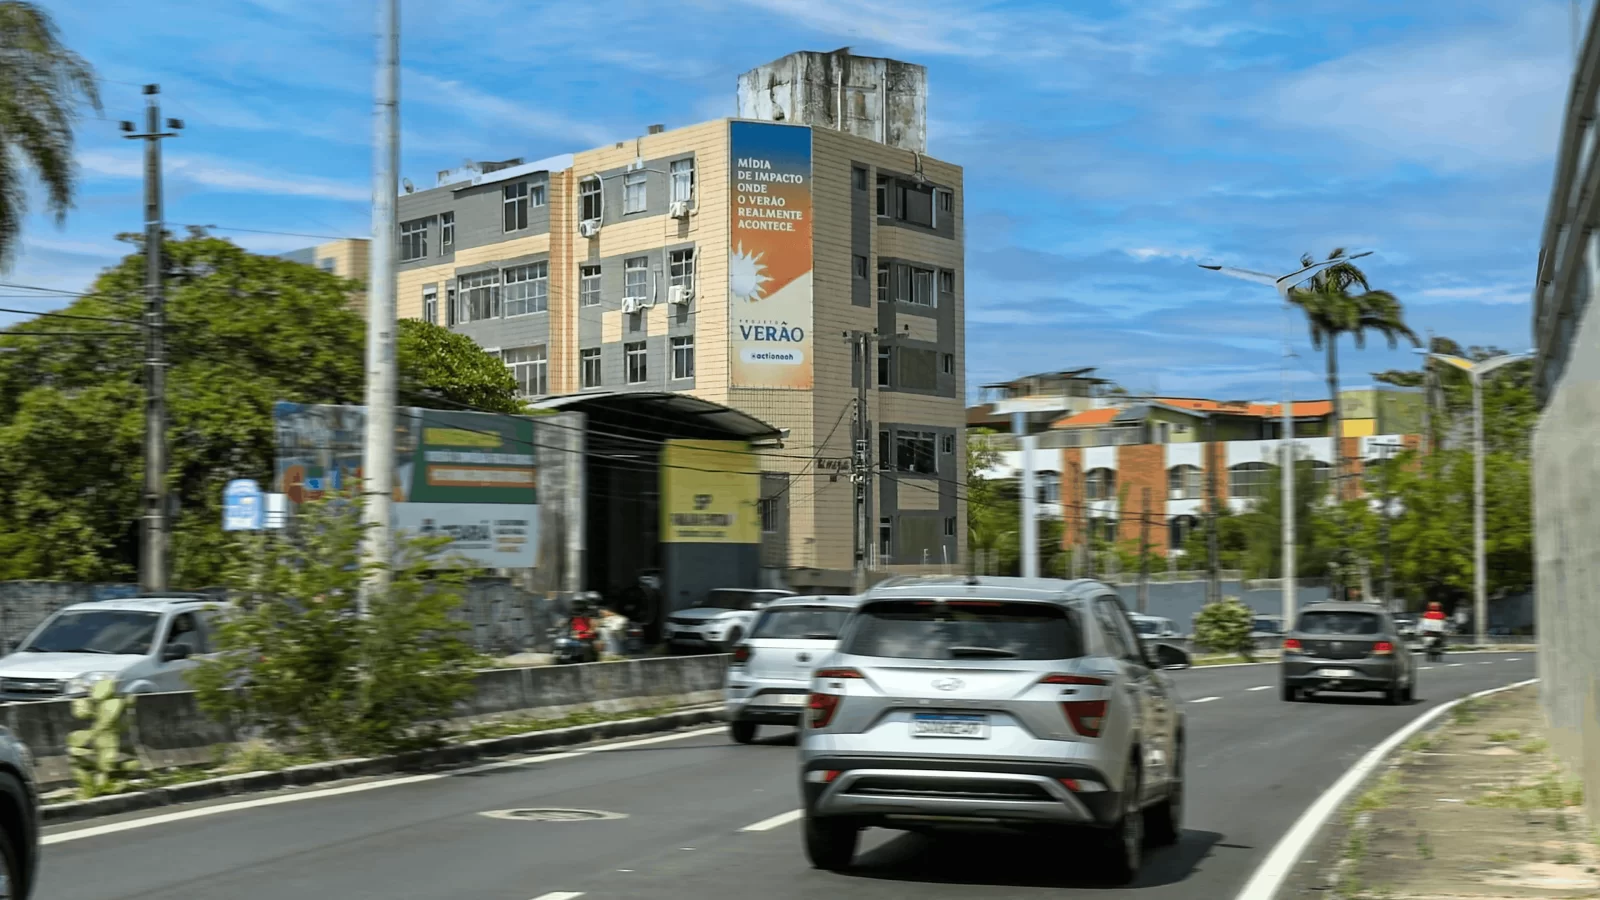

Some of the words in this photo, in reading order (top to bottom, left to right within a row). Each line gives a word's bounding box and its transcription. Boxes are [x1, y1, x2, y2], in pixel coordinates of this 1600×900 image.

[738, 157, 771, 169] MÍDIA
[738, 171, 752, 180] DE
[755, 172, 803, 184] IMPACTO
[737, 183, 767, 193] ONDE
[737, 195, 746, 204] O
[749, 195, 785, 207] VERÃO
[738, 207, 803, 220] REALMENTE
[738, 220, 796, 232] ACONTECE.
[739, 321, 804, 342] VERÃO
